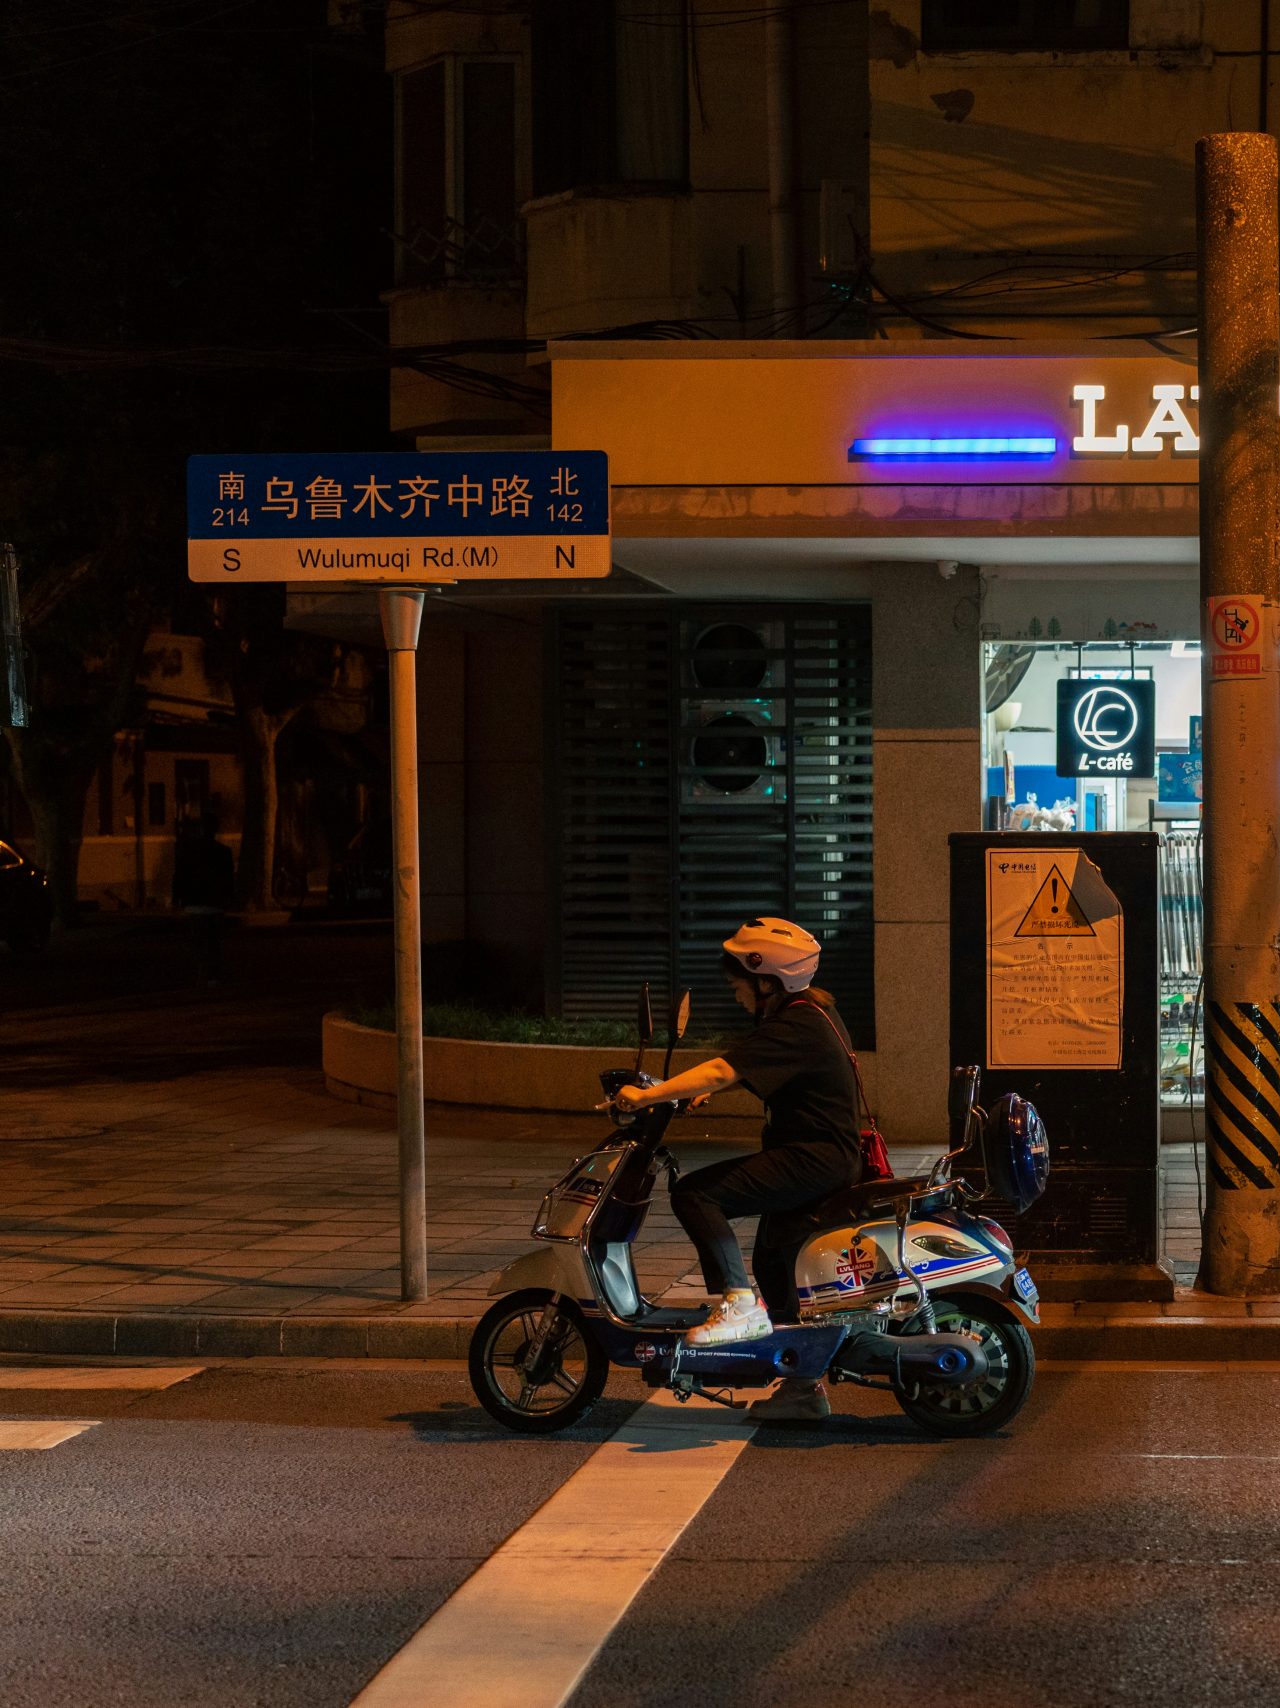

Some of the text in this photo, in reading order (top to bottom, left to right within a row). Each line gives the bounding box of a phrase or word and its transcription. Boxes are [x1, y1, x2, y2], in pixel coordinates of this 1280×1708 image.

[218, 471, 246, 500] 南
[550, 467, 579, 496] 北
[261, 474, 534, 519] 乌鲁木齐中路
[212, 508, 250, 526] 214
[547, 504, 583, 522] 142
[223, 549, 241, 571] S
[298, 546, 498, 571] Wulumuqi Rd.(M)
[555, 545, 576, 568] N
[1078, 752, 1134, 771] L-café
[839, 1262, 871, 1273] LVLIANG
